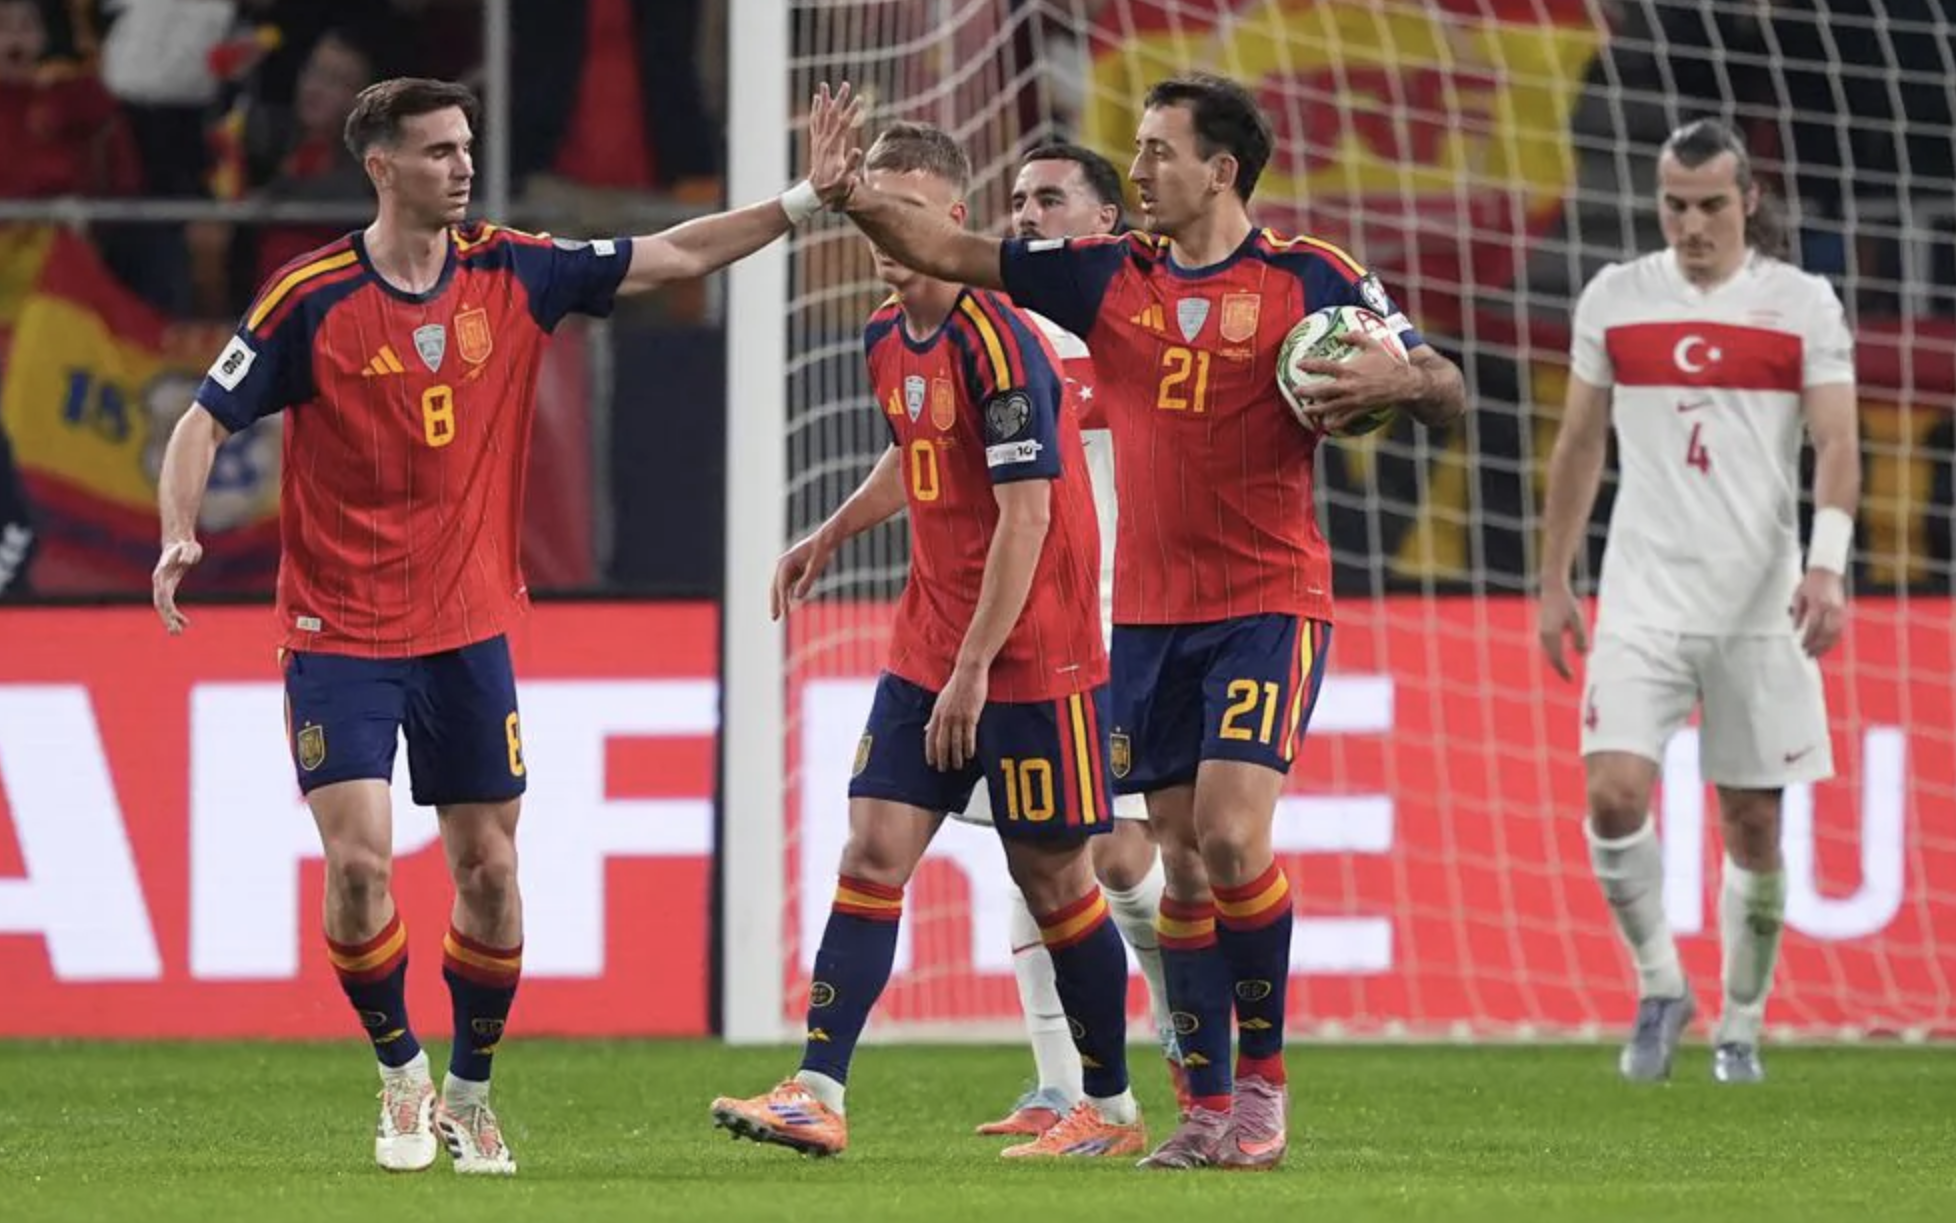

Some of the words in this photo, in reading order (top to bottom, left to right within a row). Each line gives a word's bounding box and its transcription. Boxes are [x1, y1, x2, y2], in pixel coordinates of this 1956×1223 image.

[1157, 346, 1211, 413] 21
[421, 384, 455, 447] 8
[1686, 422, 1711, 475] 4
[505, 710, 524, 777] 8
[1219, 678, 1279, 745] 21
[1000, 757, 1055, 821] 10
